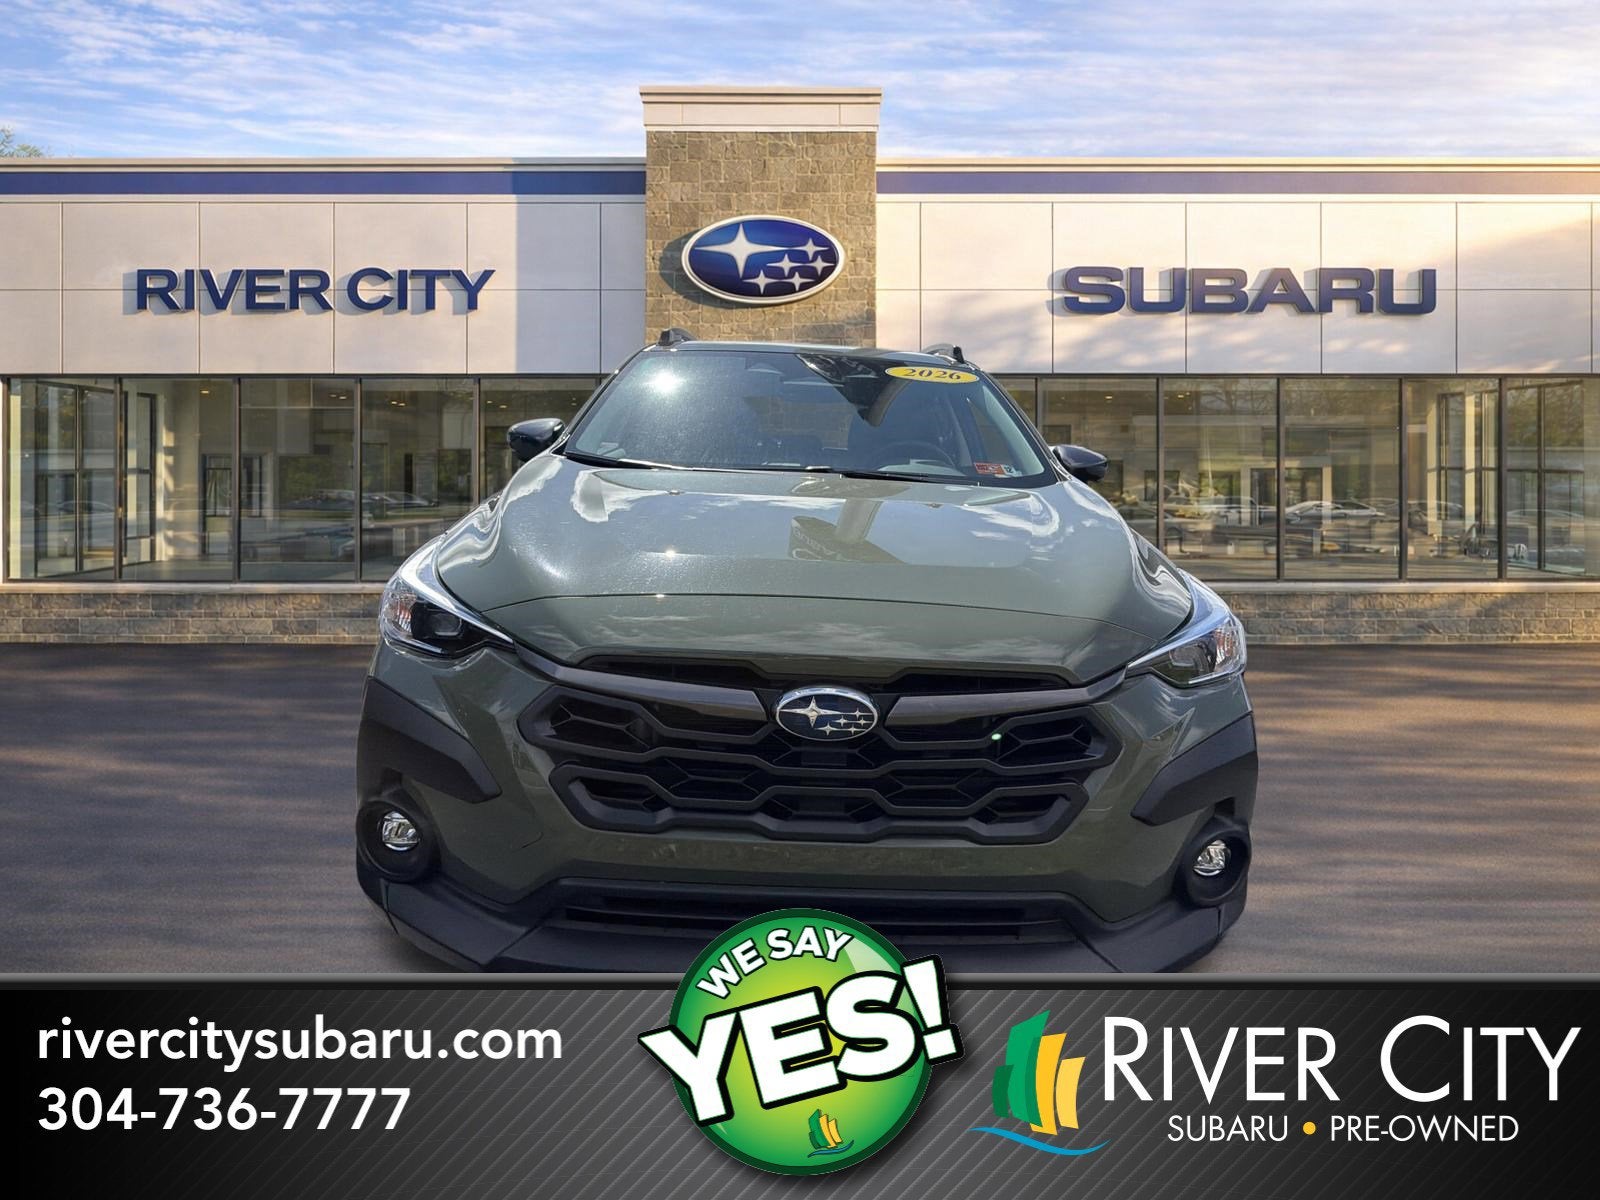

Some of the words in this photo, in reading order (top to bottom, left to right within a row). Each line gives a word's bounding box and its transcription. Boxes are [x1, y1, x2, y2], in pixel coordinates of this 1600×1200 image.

[136, 268, 334, 311] RIVER
[346, 267, 496, 311] CITY
[1063, 266, 1437, 314] SUBARU
[903, 368, 961, 380] 2026
